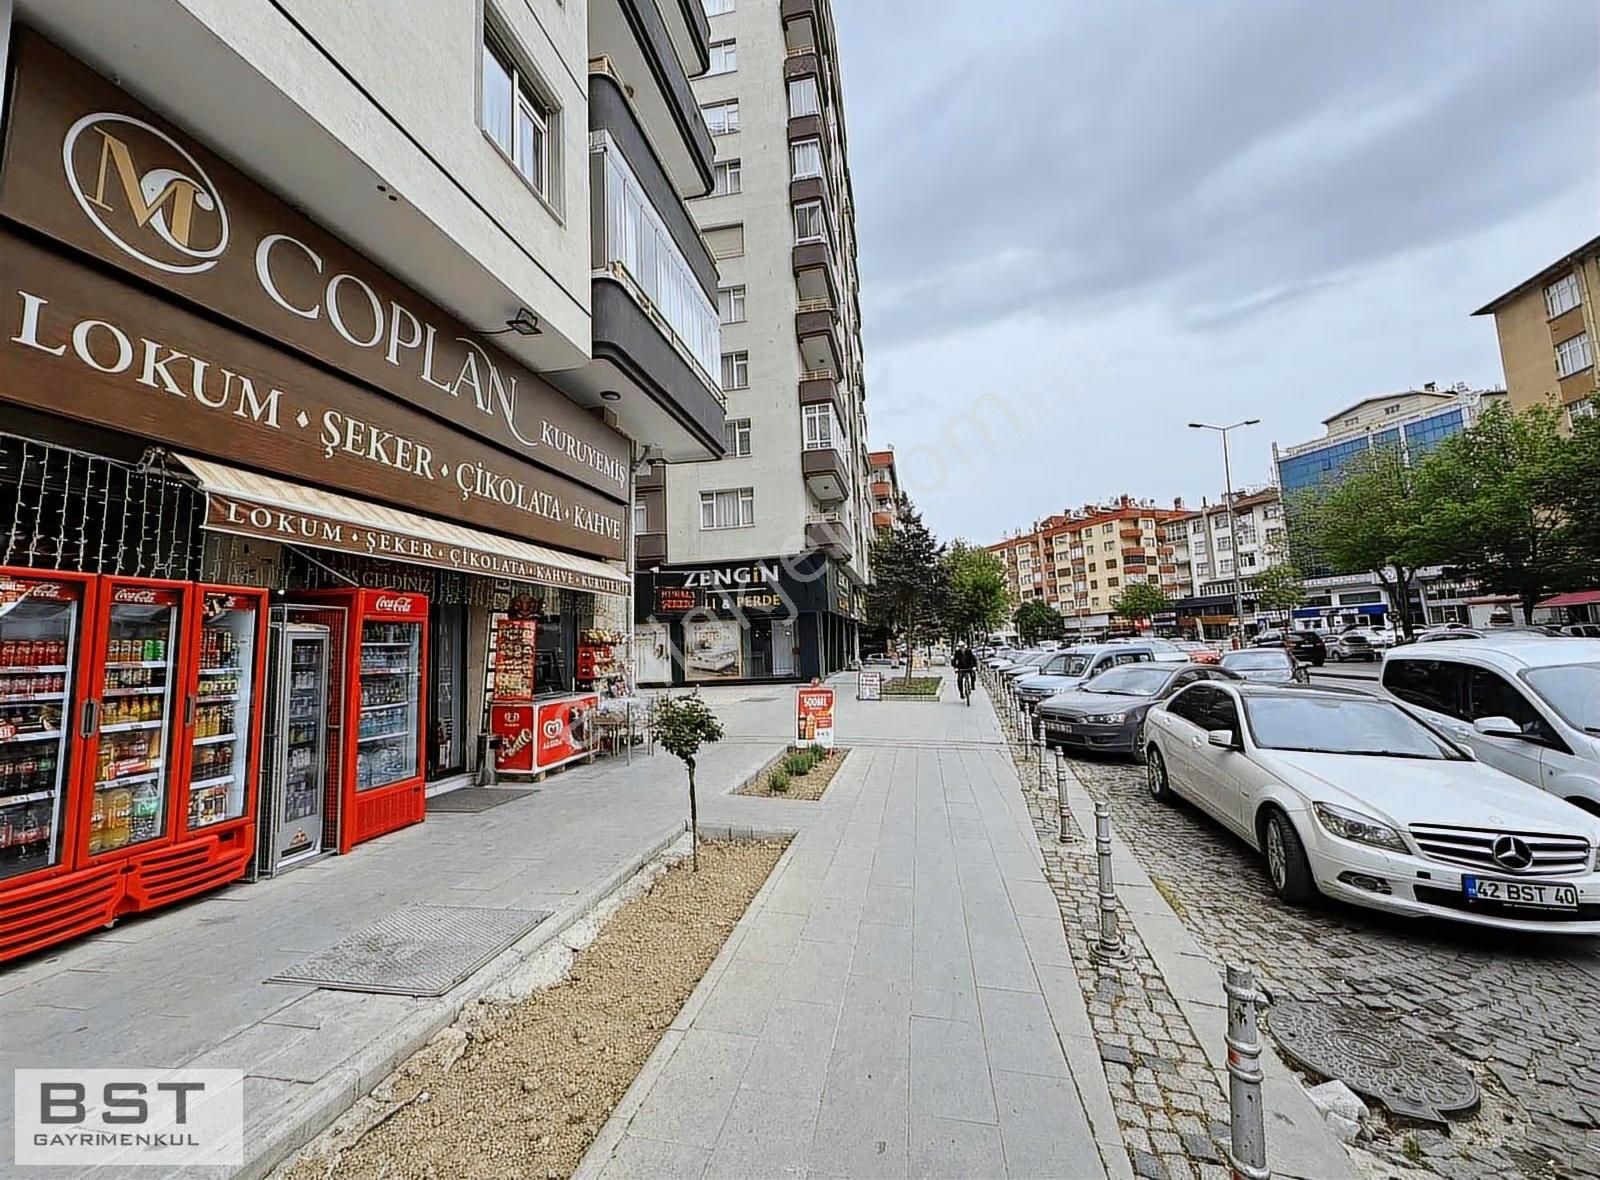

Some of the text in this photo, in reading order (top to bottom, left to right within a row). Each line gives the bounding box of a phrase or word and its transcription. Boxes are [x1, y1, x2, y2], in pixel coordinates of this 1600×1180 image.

[255, 234, 539, 446] COPLAN
[10, 290, 621, 541] LOKUM ŞEKER ÇİKOLATA KAHVE
[539, 420, 626, 488] KURUYEMİŞ
[226, 502, 342, 542] LOKUM
[366, 532, 434, 558] ŞEKER
[449, 548, 526, 575] ÇİKOLATA
[536, 564, 574, 585] KAHVE
[736, 594, 781, 608] PERDE
[1477, 881, 1501, 899] 42
[1506, 884, 1546, 903] BST
[1554, 888, 1575, 905] 40
